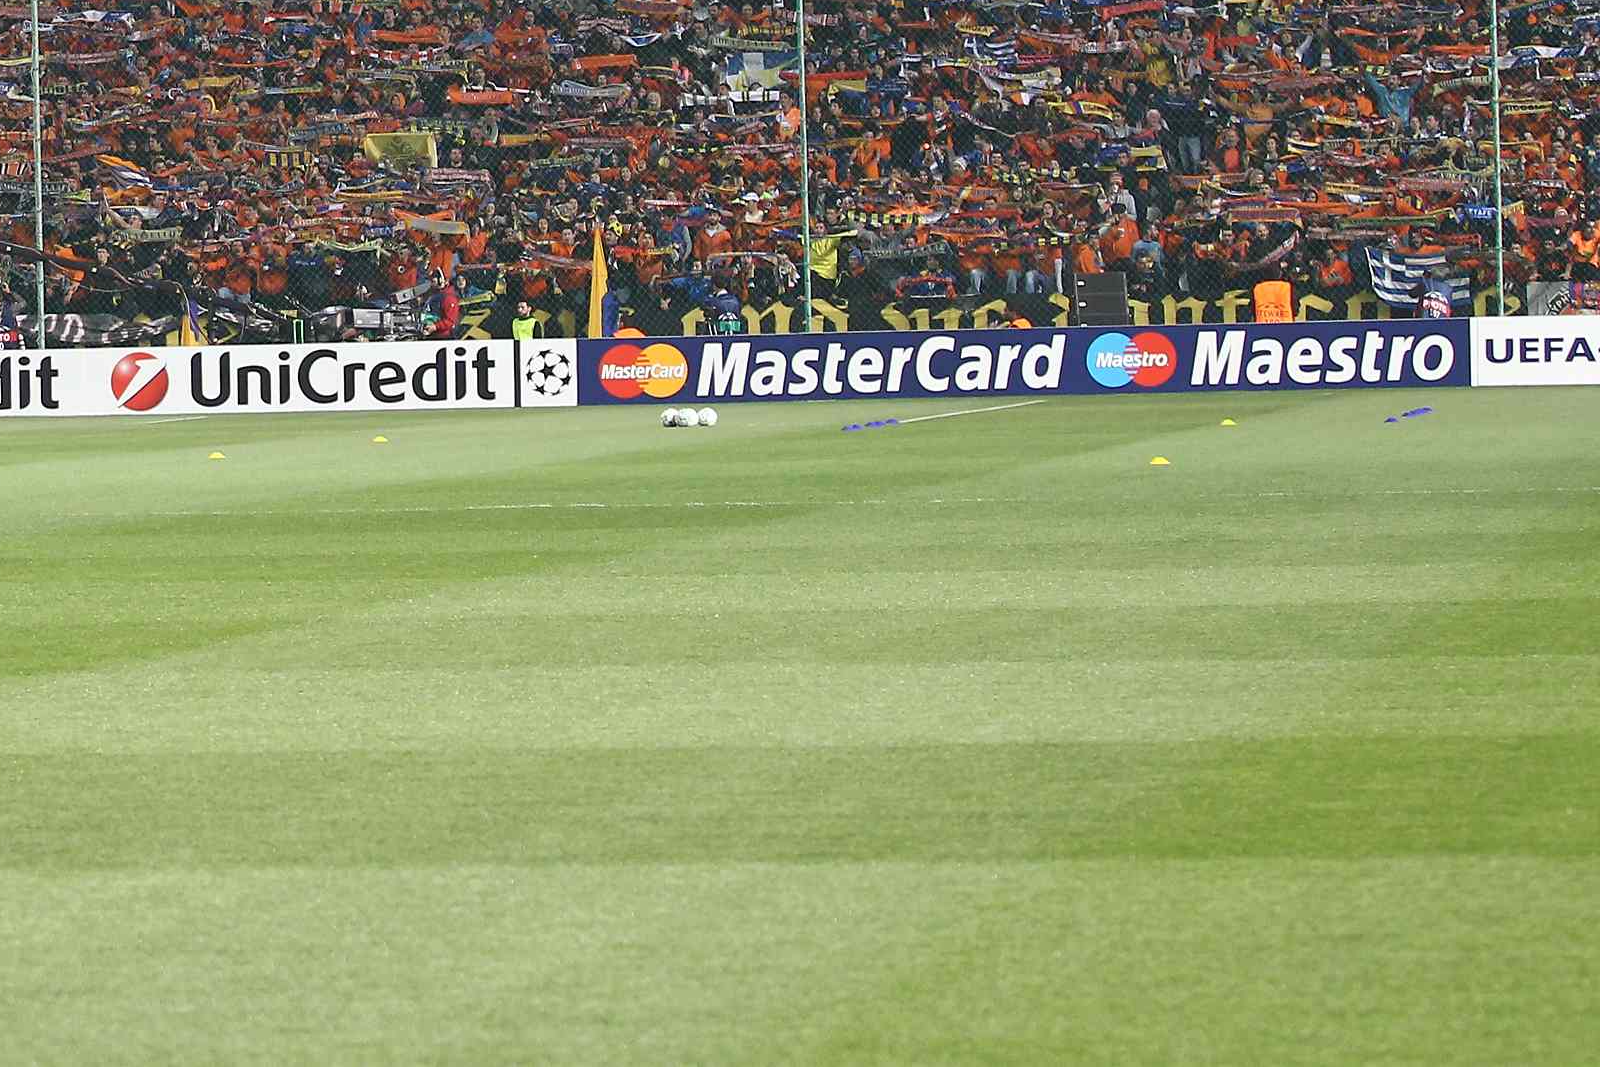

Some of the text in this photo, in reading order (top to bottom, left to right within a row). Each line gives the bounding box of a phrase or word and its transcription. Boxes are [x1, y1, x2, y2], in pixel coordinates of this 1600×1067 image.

[601, 362, 685, 380] MasterCard
[696, 334, 1067, 398] MasterCard
[1095, 351, 1168, 368] Maestro
[1190, 330, 1455, 385] Maestro
[1485, 337, 1597, 364] UEFA
[190, 346, 496, 408] UniCredit
